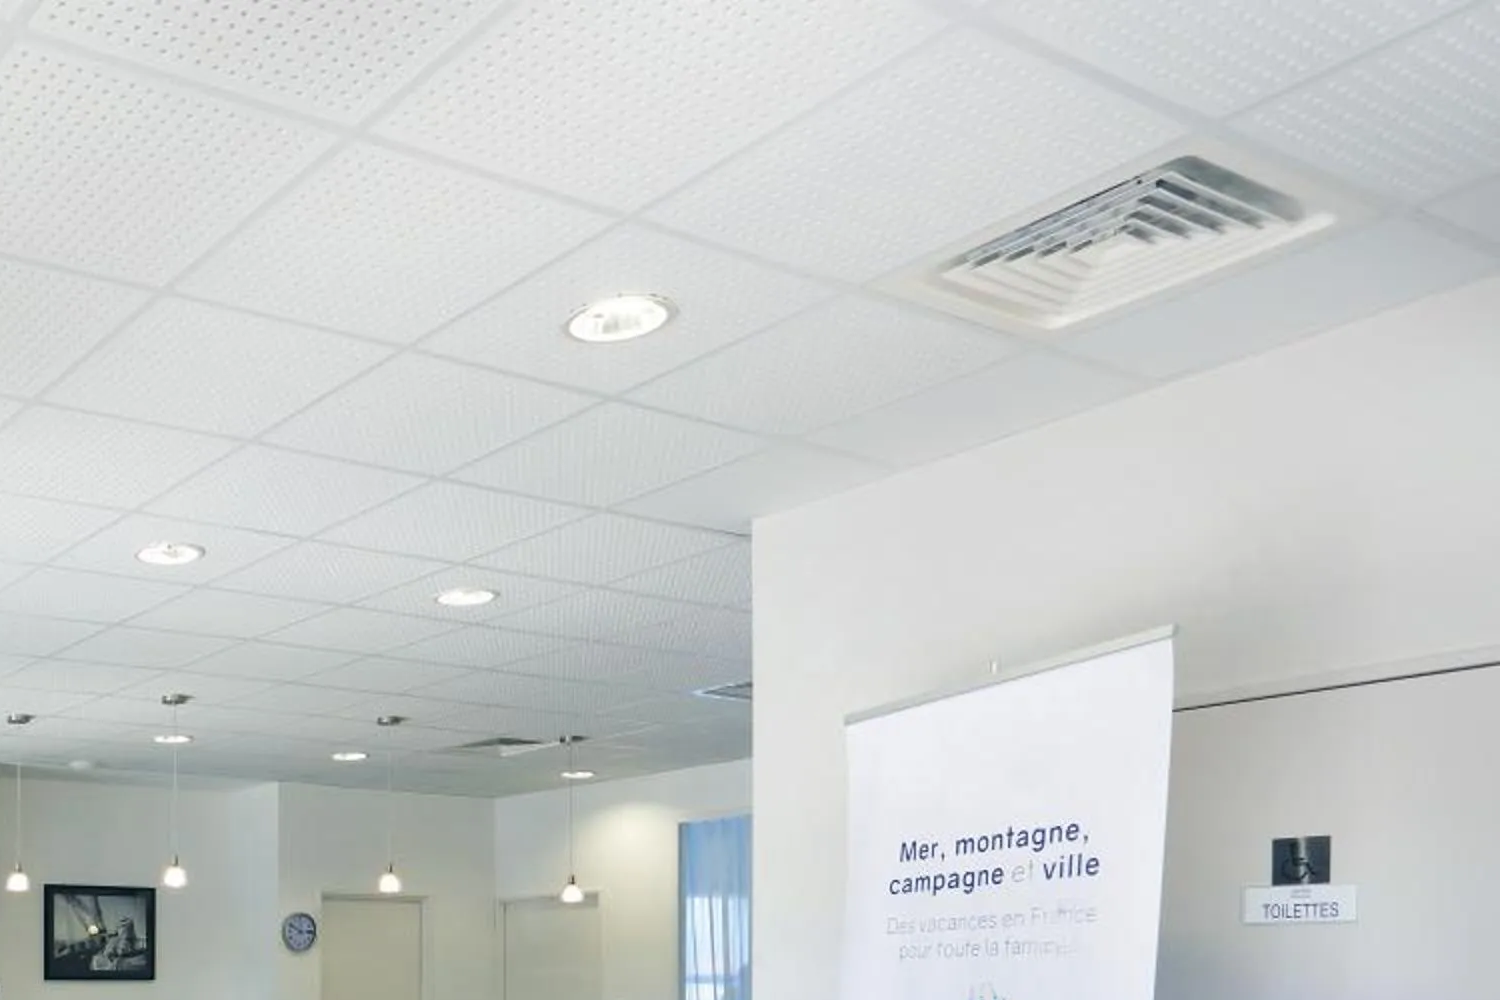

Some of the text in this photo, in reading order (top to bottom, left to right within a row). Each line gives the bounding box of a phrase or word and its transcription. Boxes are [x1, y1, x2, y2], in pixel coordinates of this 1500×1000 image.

[899, 822, 1089, 862] Mer, montagne,
[888, 853, 1100, 896] campagne et ville
[1262, 902, 1339, 919] TOILETTES
